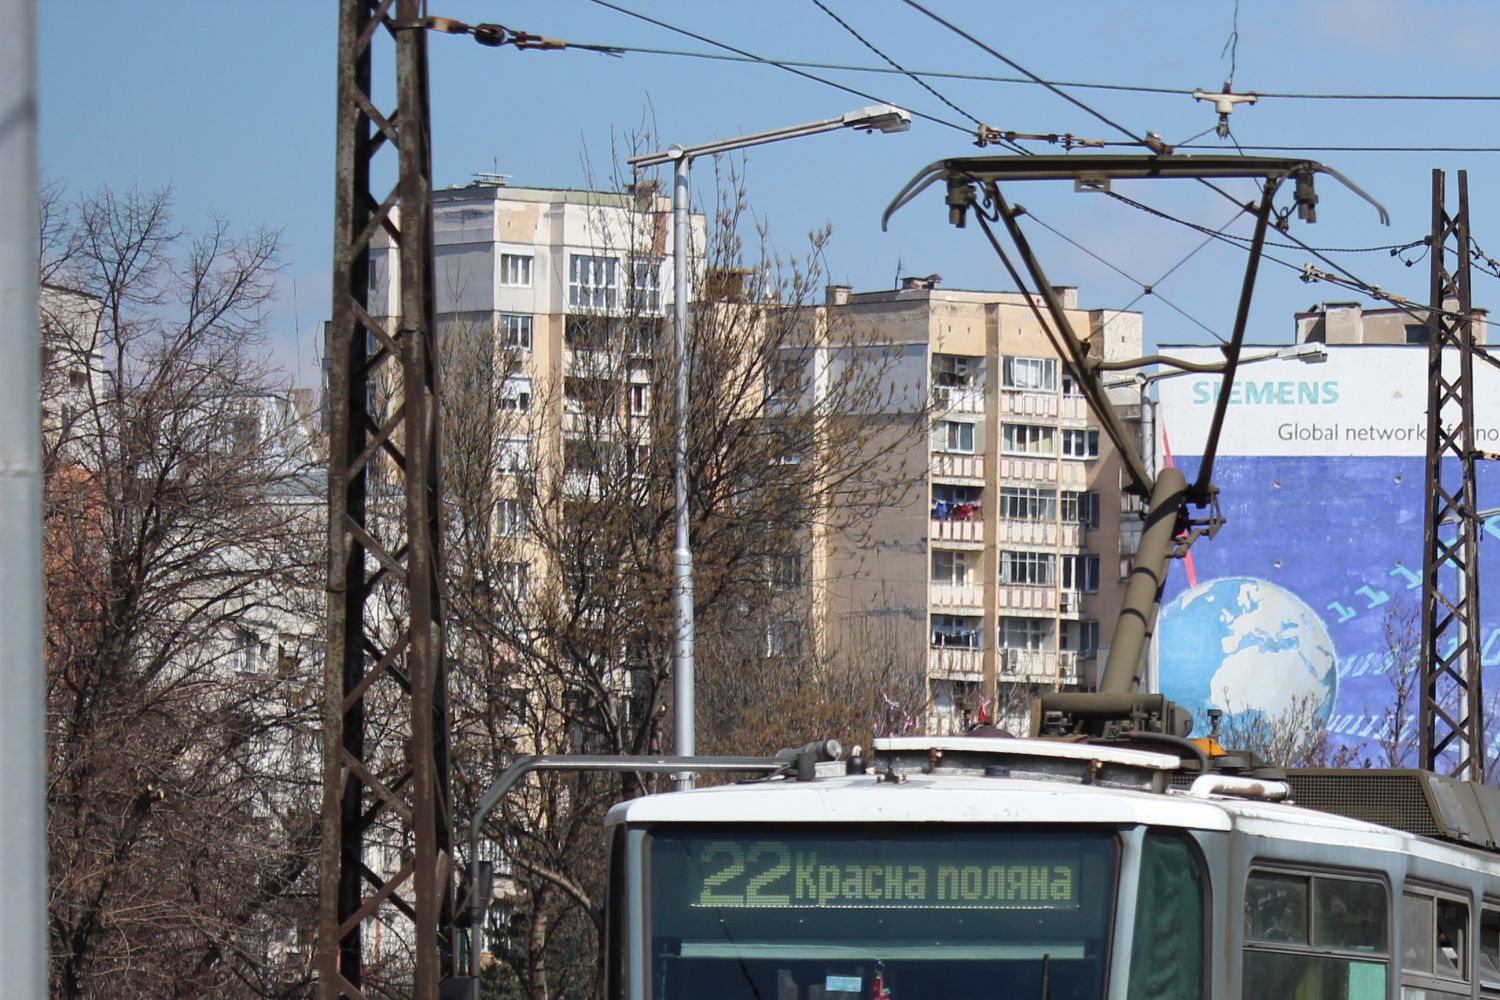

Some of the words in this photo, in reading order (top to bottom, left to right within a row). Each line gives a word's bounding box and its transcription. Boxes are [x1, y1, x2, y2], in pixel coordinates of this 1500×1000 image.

[1192, 381, 1340, 405] SIEMENS
[1277, 423, 1338, 441] Global
[1346, 423, 1426, 441] network
[700, 841, 790, 906] 22
[796, 851, 926, 906] Красна
[938, 866, 1072, 900] поляна
